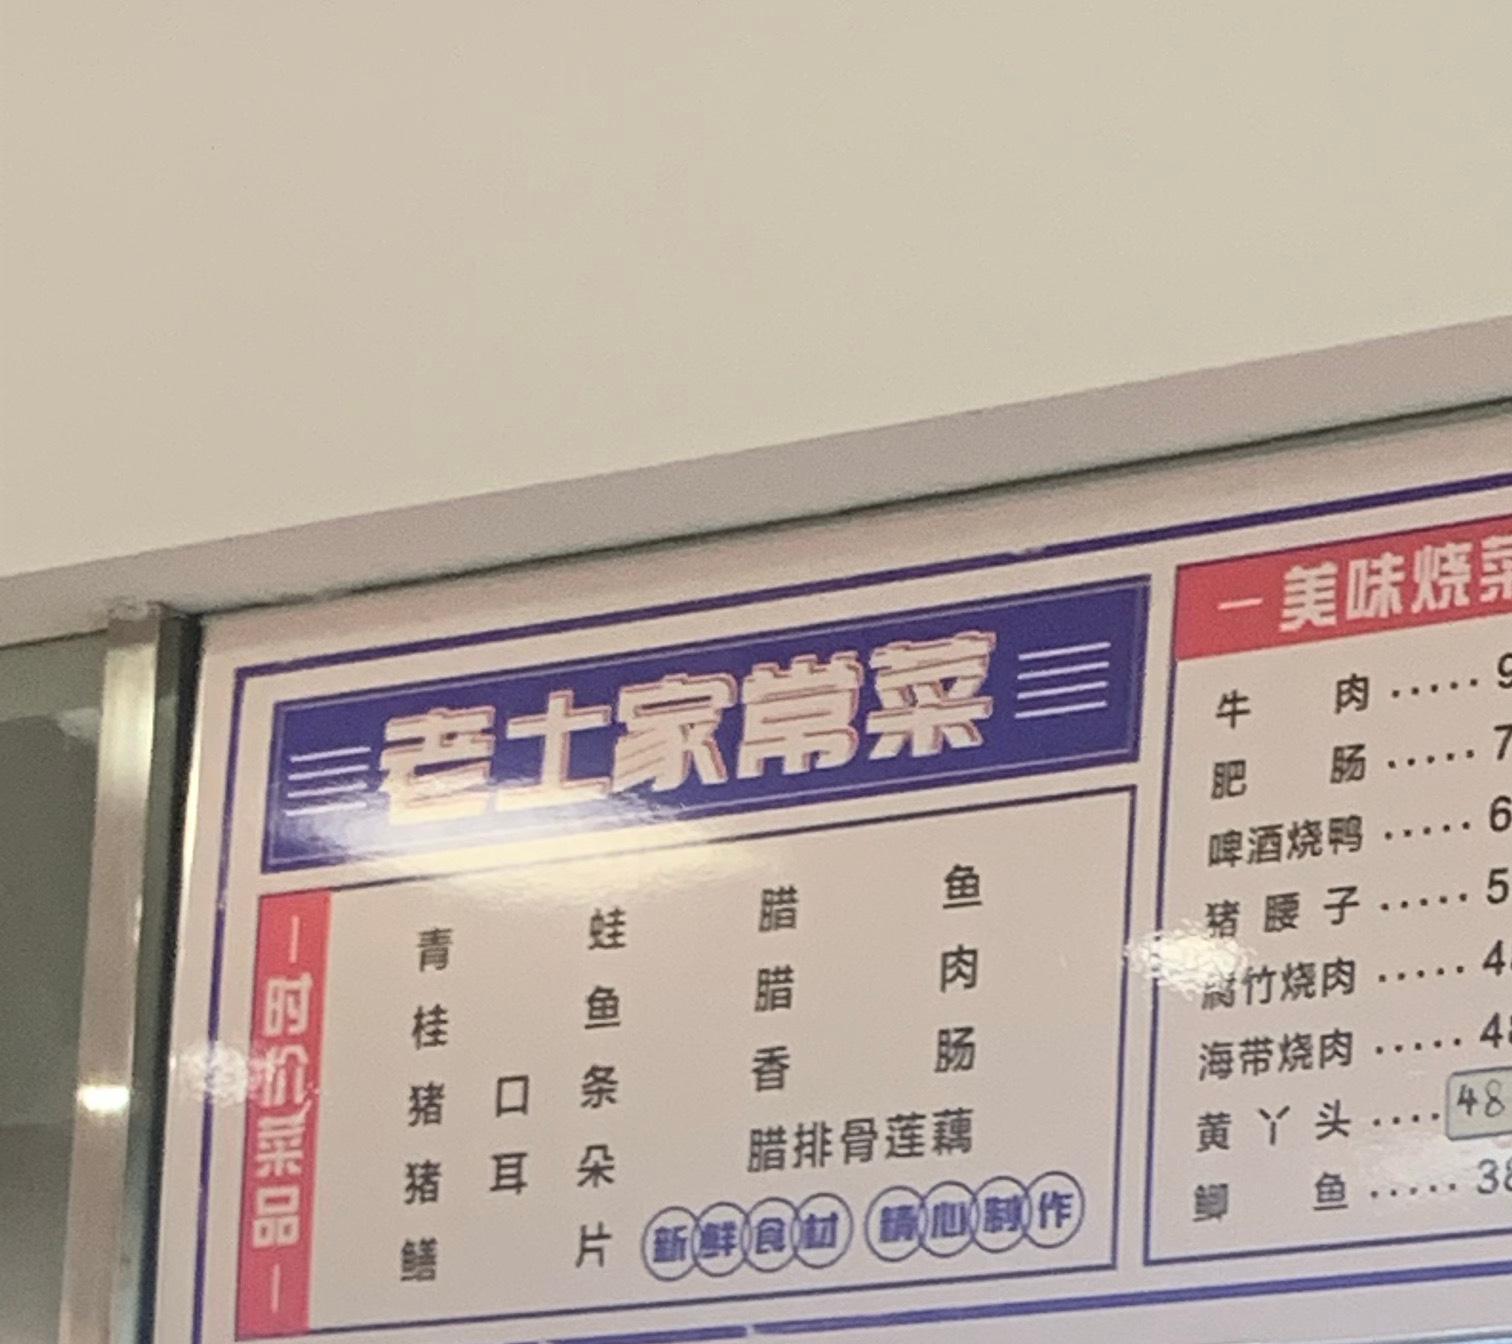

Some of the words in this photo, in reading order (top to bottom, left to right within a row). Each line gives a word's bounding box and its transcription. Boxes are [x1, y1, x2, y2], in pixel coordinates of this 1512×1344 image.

[1208, 815, 1364, 870] 啤酒烧鸭
[759, 862, 983, 932] 腊鱼
[1205, 885, 1360, 939] 猪腰子
[417, 907, 627, 972] 青蛙
[754, 944, 979, 1013] 腊肉
[411, 985, 621, 1050] 桂鱼
[751, 1027, 975, 1092] 香肠
[1199, 1027, 1353, 1081] 海带烧肉
[252, 972, 316, 1249] 时价菜品
[408, 1065, 619, 1127] 猪口条
[1196, 1099, 1351, 1153] 黄丫头
[748, 1107, 974, 1173] 腊排骨莲藕
[404, 1144, 615, 1205] 猪耳朵
